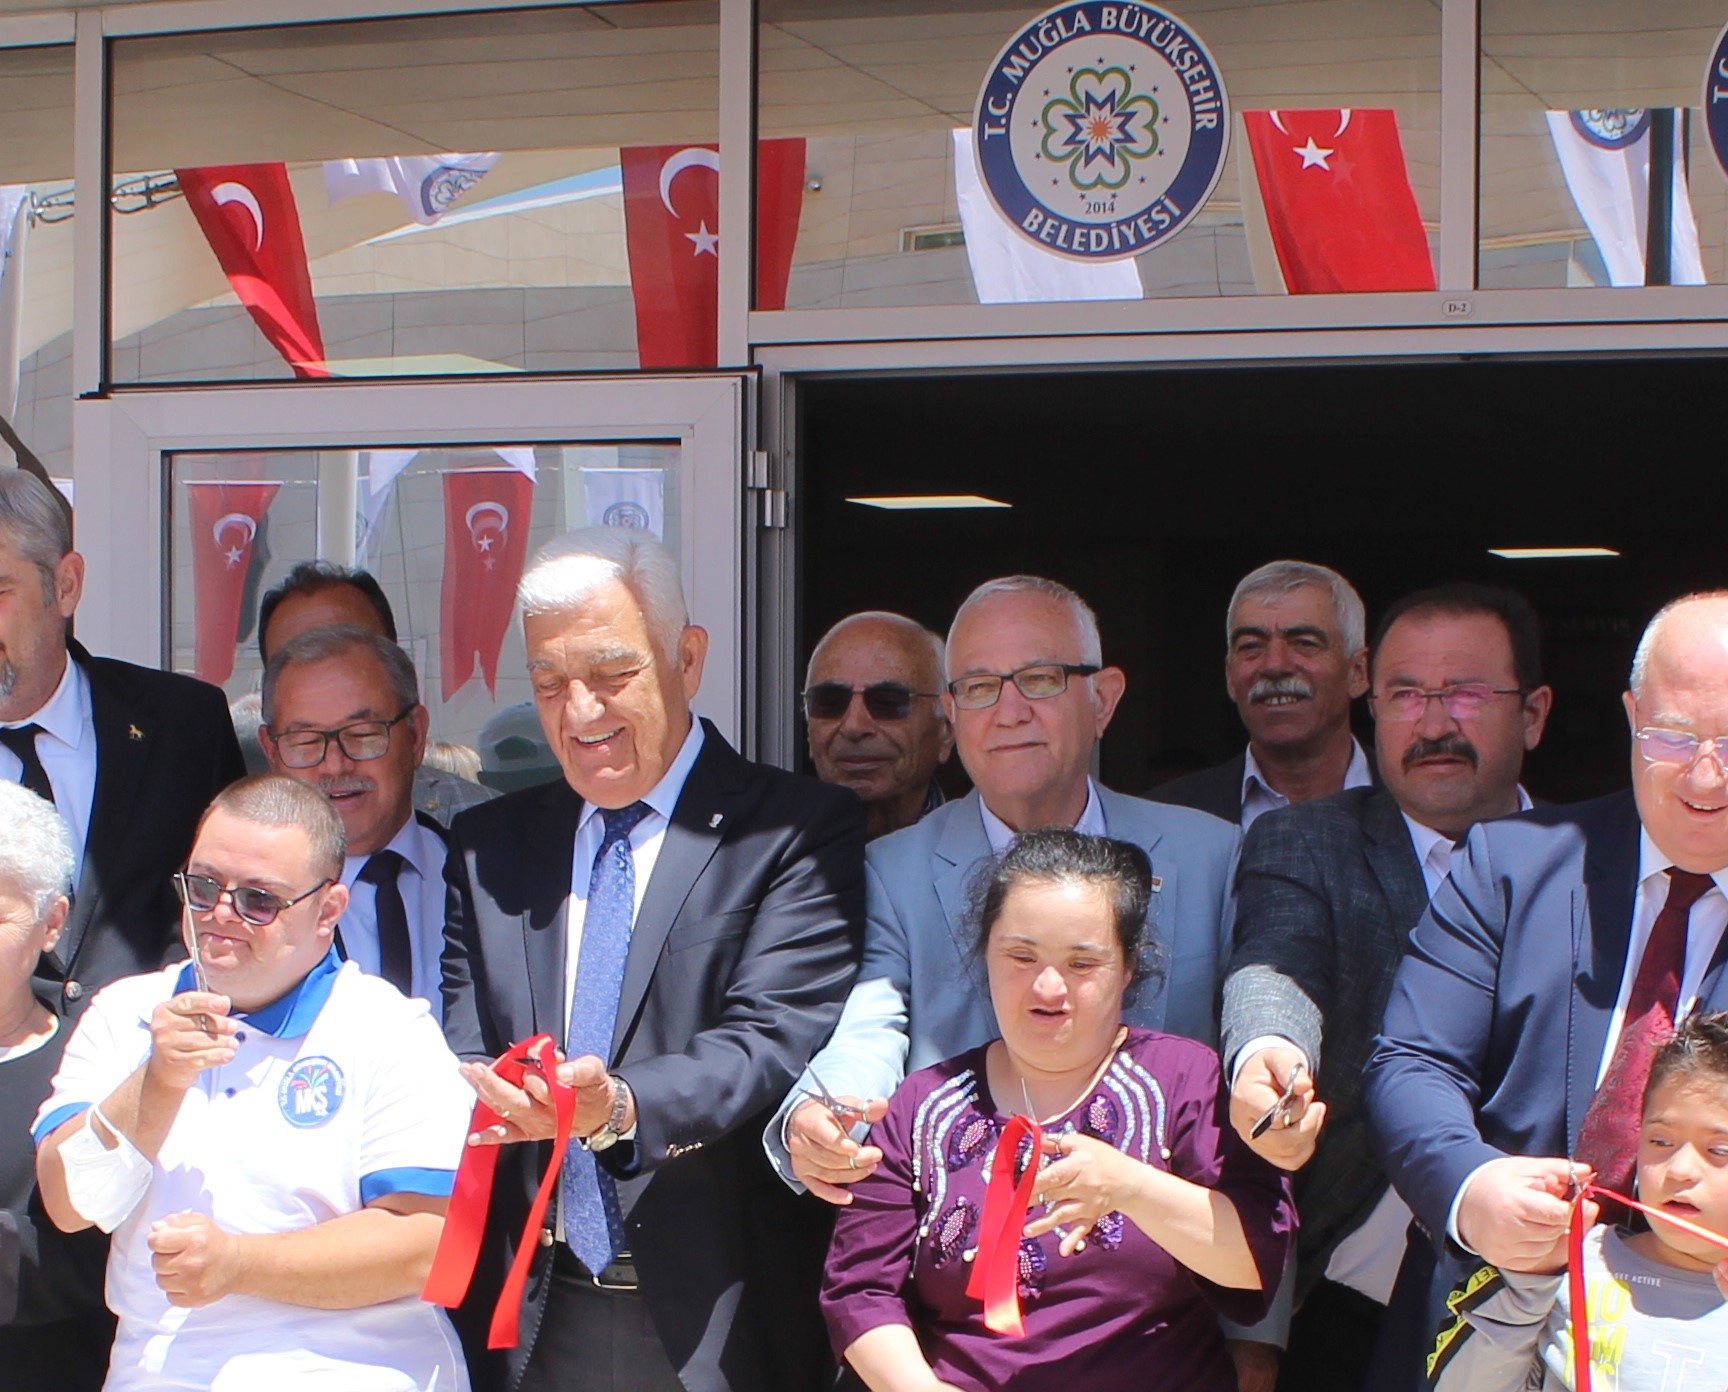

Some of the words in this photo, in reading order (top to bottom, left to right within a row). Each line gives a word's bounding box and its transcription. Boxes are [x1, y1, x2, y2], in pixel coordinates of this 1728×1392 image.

[984, 92, 1013, 140] T.C.
[1002, 9, 1091, 85] MUĞLA
[1101, 4, 1221, 133] BÜYÜKŞEHİR
[1022, 193, 1182, 252] BELEDİYESİ
[1084, 200, 1116, 215] 2014
[1632, 1274, 1661, 1287] ACTIVE
